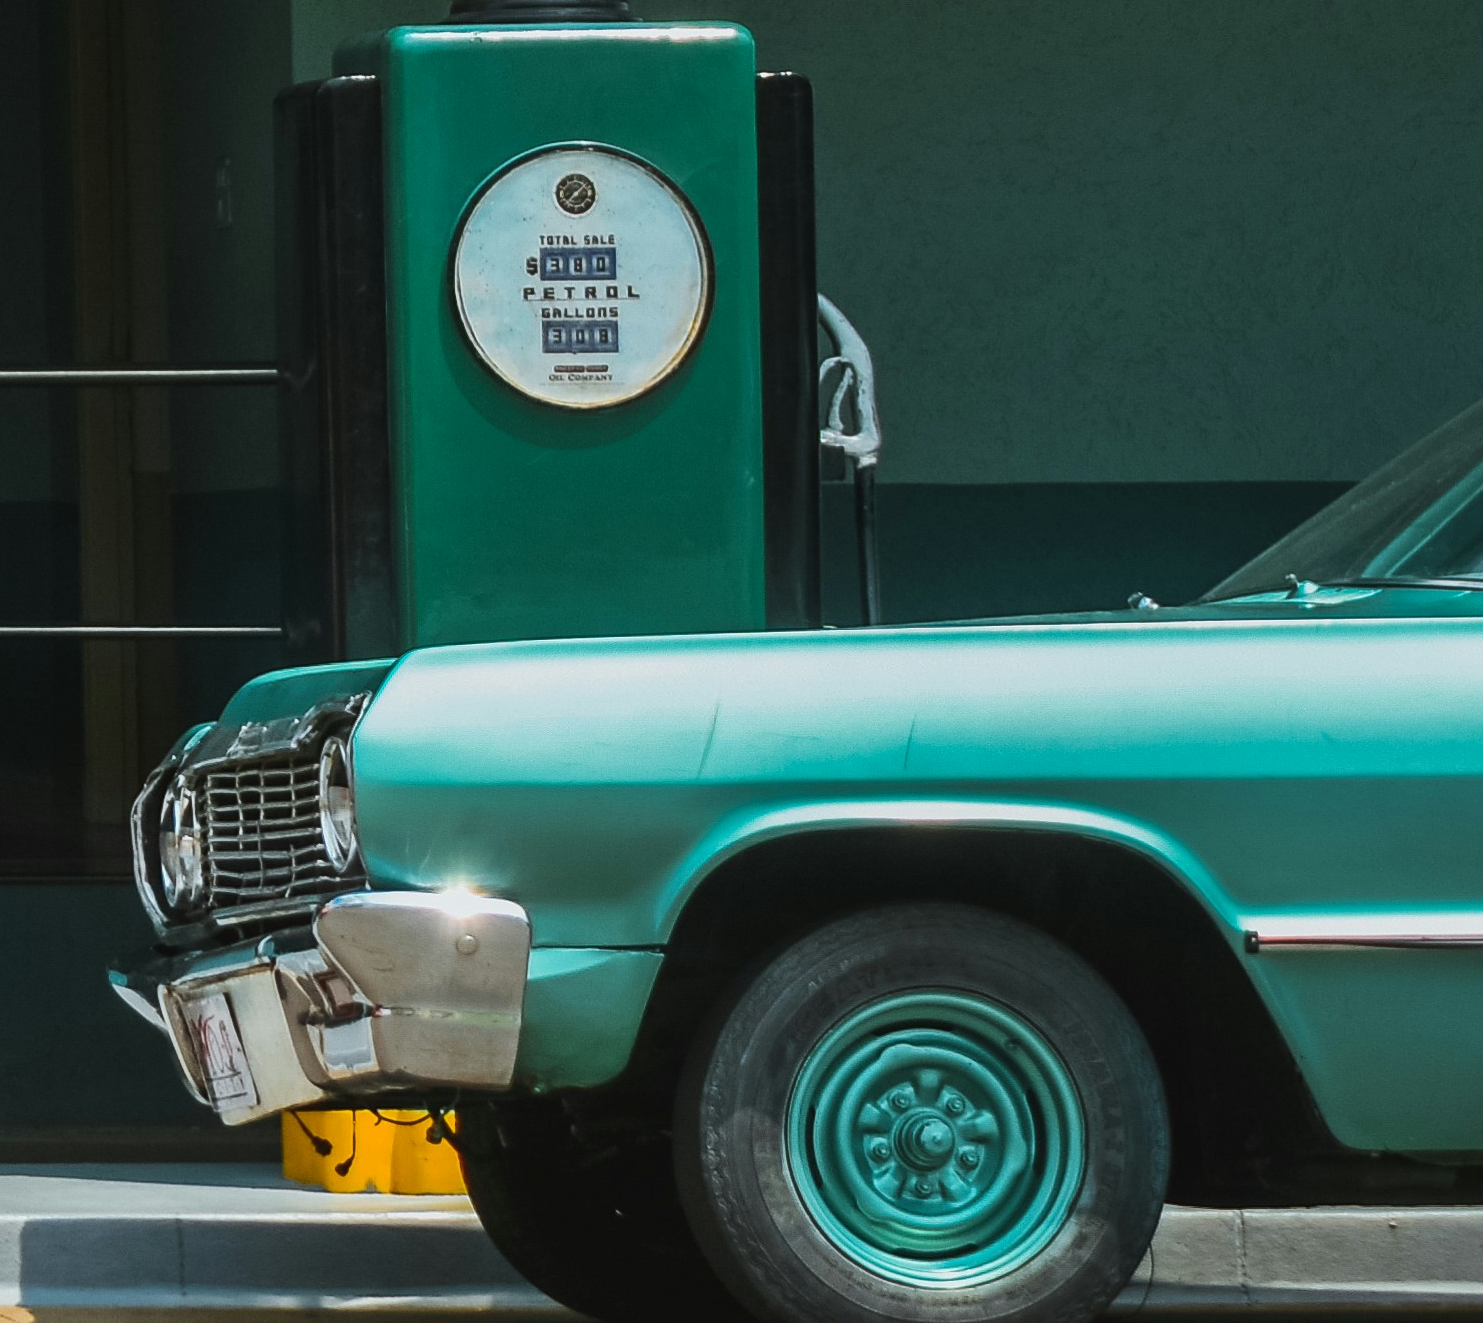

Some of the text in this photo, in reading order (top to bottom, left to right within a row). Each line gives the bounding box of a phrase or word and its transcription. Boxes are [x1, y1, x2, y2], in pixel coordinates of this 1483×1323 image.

[539, 234, 615, 245] TOTAL SALE
[523, 285, 640, 301] PETROL
[541, 307, 619, 318] GALLONS
